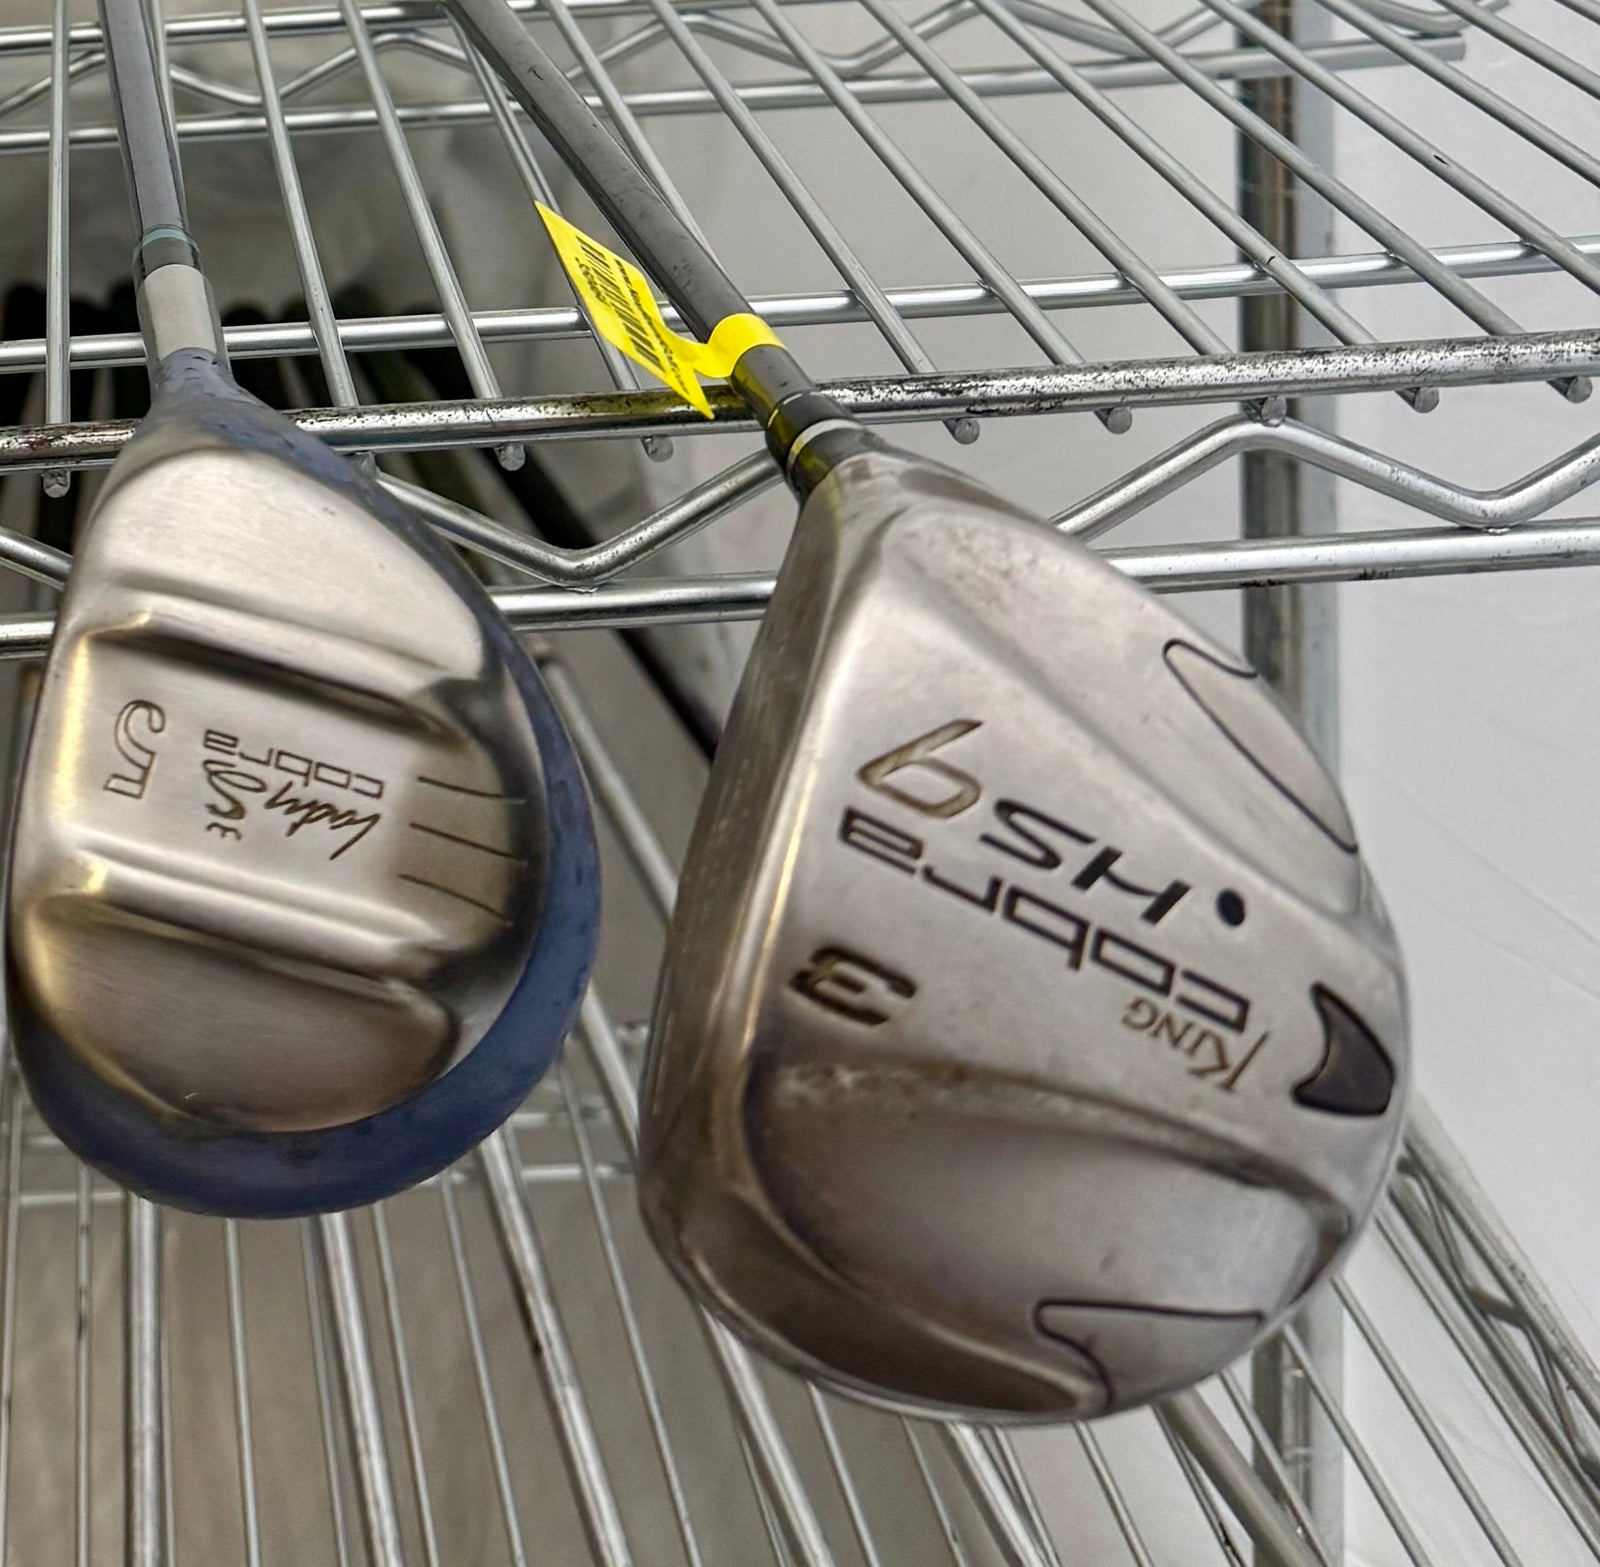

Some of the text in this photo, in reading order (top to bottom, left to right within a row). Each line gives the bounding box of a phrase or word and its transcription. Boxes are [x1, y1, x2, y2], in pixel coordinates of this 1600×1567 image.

[104, 700, 165, 799] 5
[203, 729, 384, 799] cobra
[265, 781, 381, 860] Lady
[840, 807, 1250, 1033] cobra
[788, 944, 917, 1026] 3
